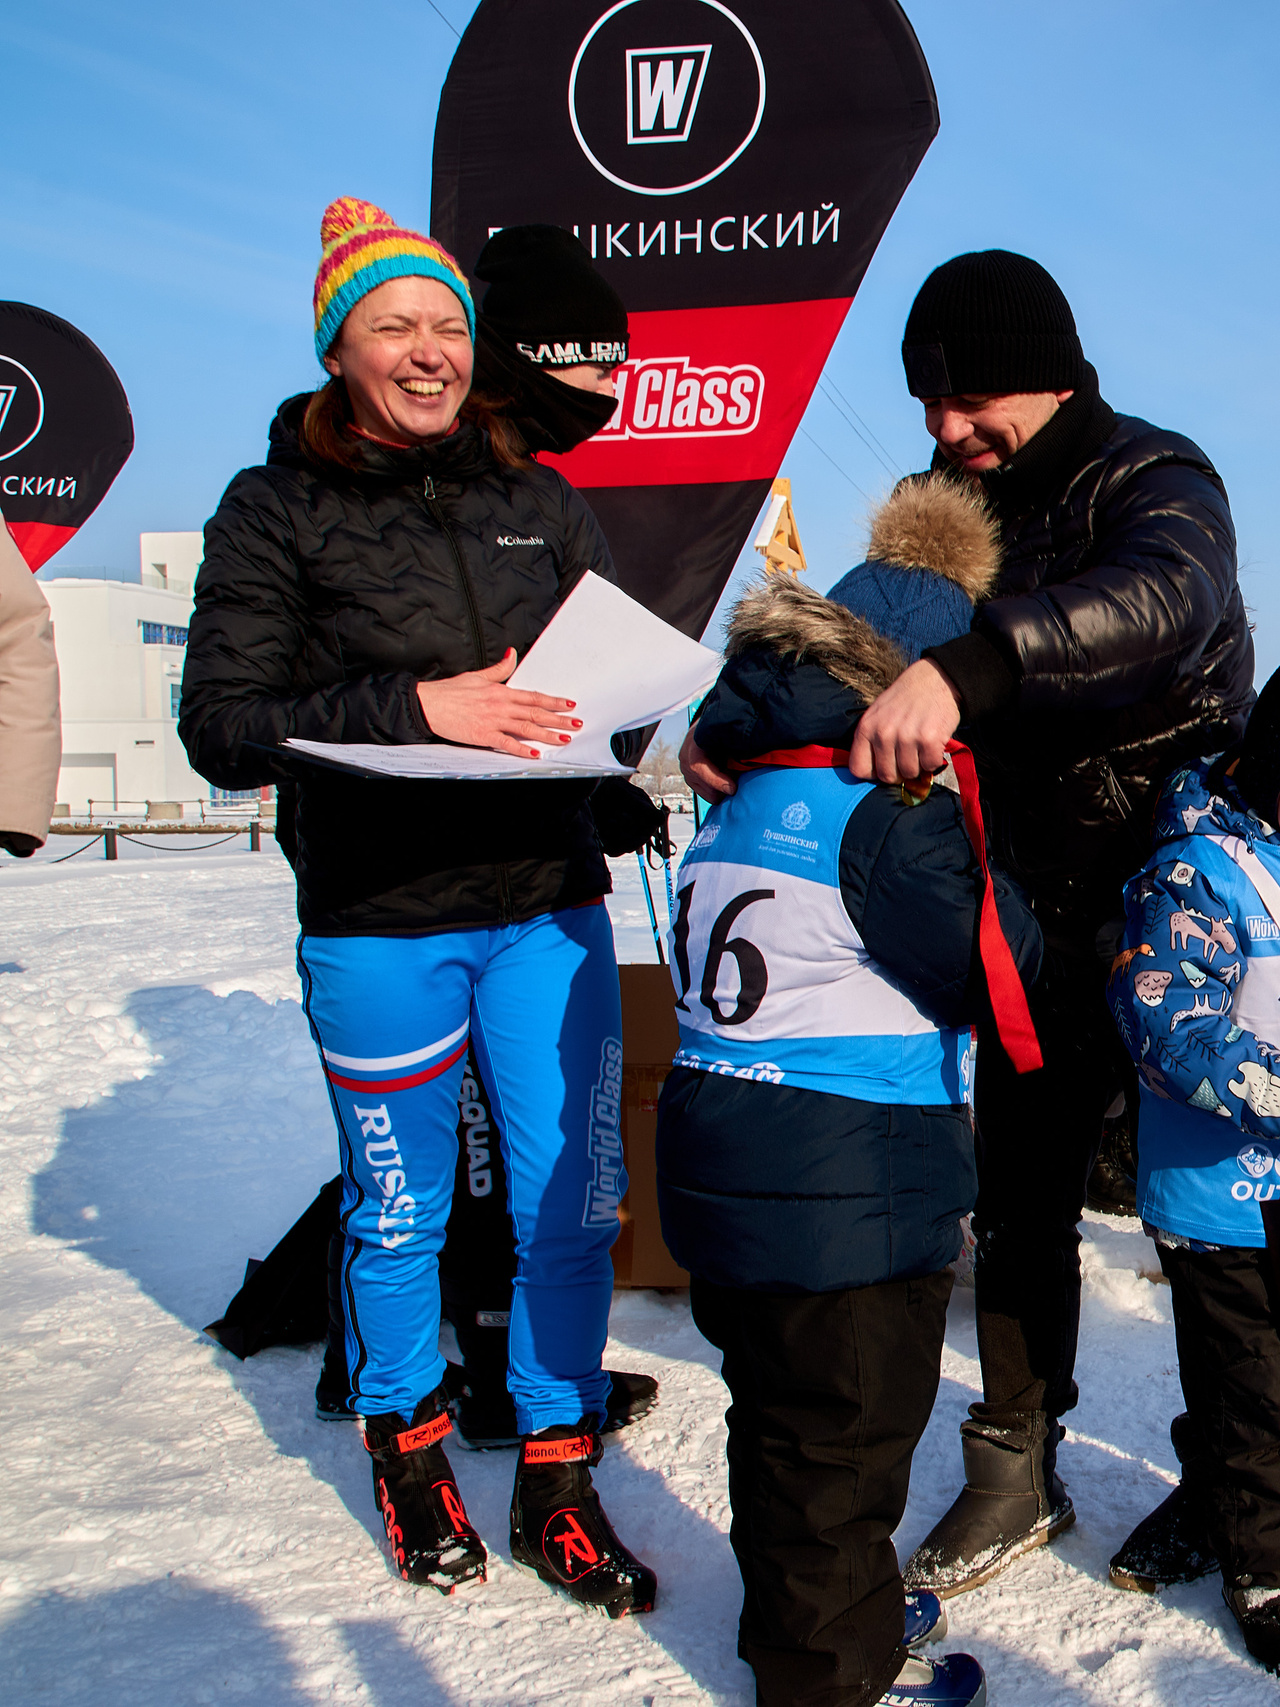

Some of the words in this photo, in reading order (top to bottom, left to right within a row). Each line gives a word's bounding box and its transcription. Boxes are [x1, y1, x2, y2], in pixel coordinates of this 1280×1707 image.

[488, 202, 841, 259] КИНСКИЙ
[632, 369, 755, 429] Class
[504, 535, 545, 546] Columbia
[763, 829, 819, 850] Пушкинский
[673, 879, 776, 1026] 16
[599, 1043, 623, 1127] Class
[461, 1060, 494, 1198] SQUAD
[352, 1103, 417, 1251] RUSSIA
[590, 1127, 622, 1225] World
